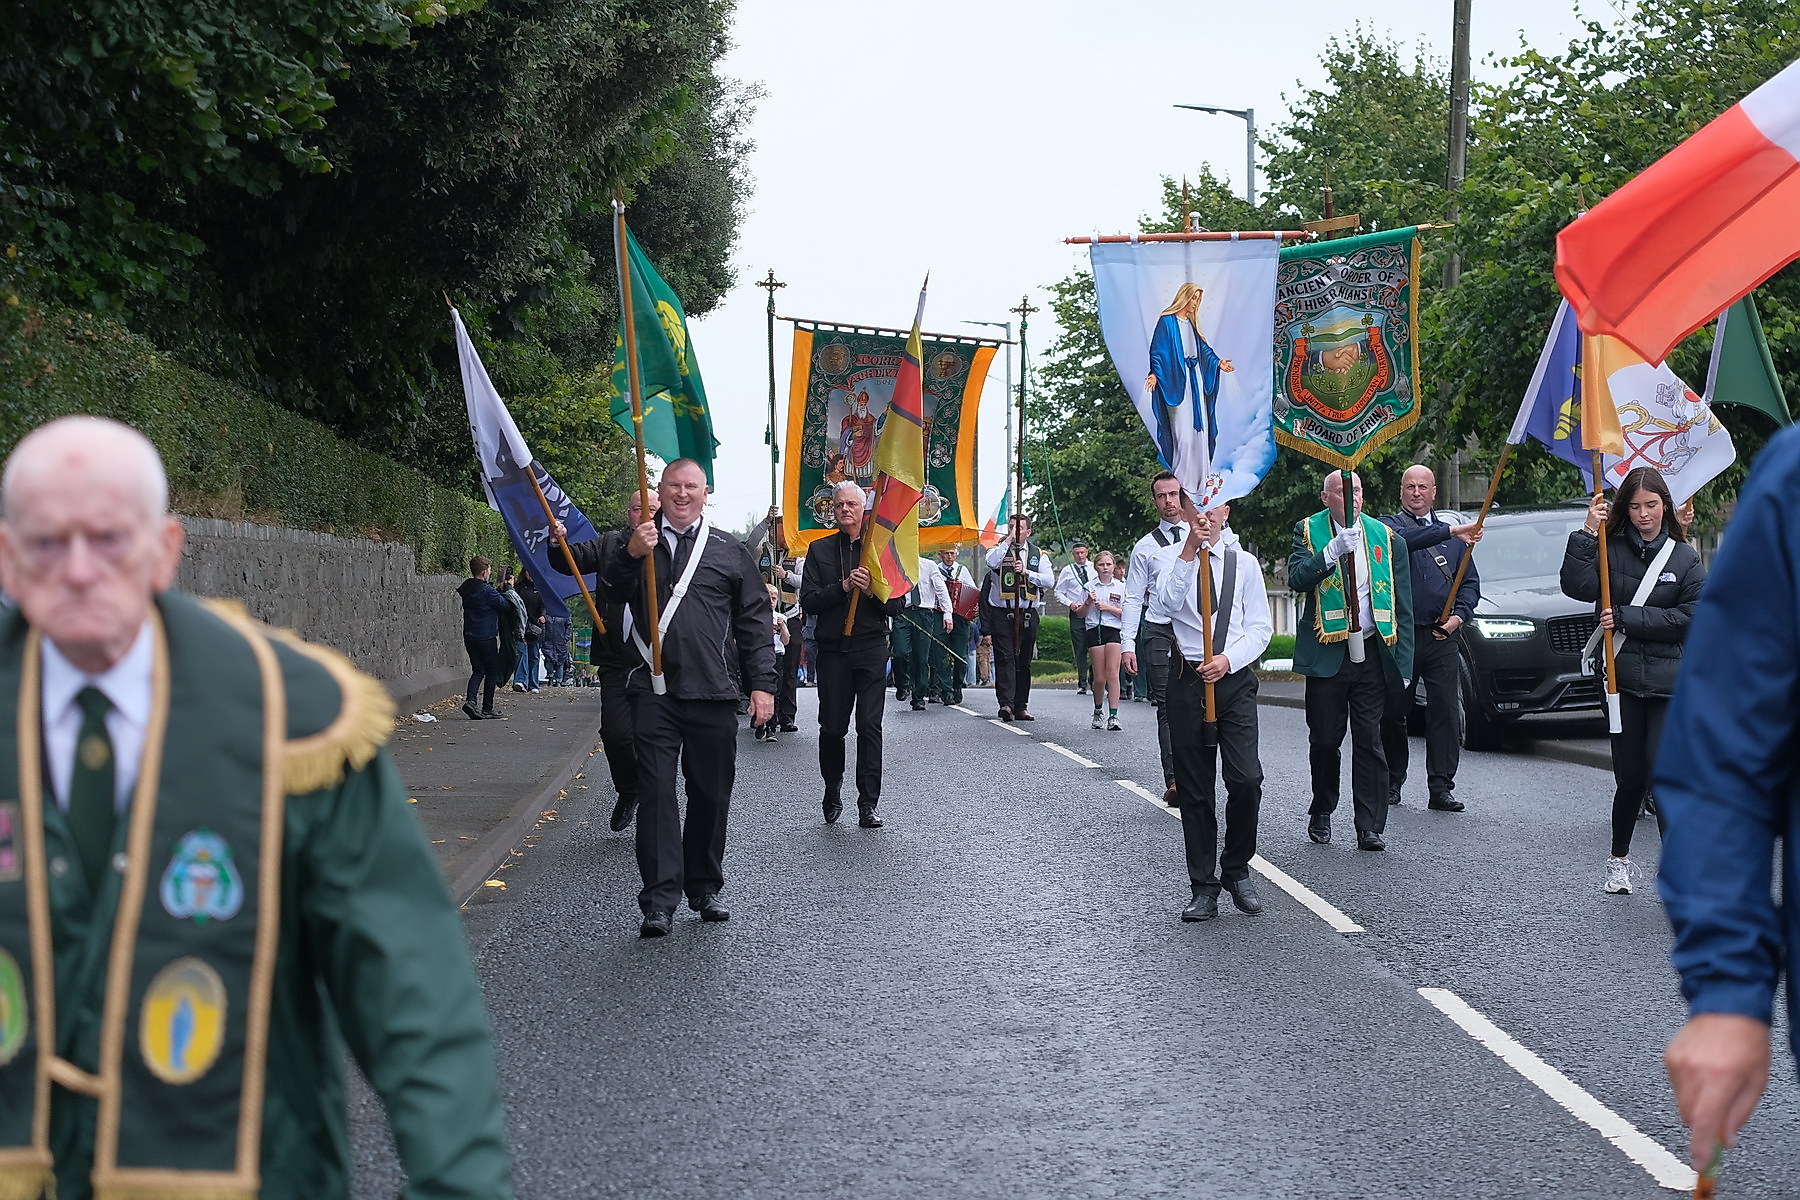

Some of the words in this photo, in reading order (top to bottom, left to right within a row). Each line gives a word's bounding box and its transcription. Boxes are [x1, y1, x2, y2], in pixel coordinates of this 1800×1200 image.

[1279, 270, 1332, 300] ANCIENT
[1340, 267, 1372, 284] ORDER
[1305, 286, 1367, 311] HIBERNIANS
[1351, 378, 1379, 415] CHRISTIAN
[1307, 418, 1343, 443] BOARD
[1346, 429, 1358, 443] OF
[1360, 410, 1381, 435] ERIN
